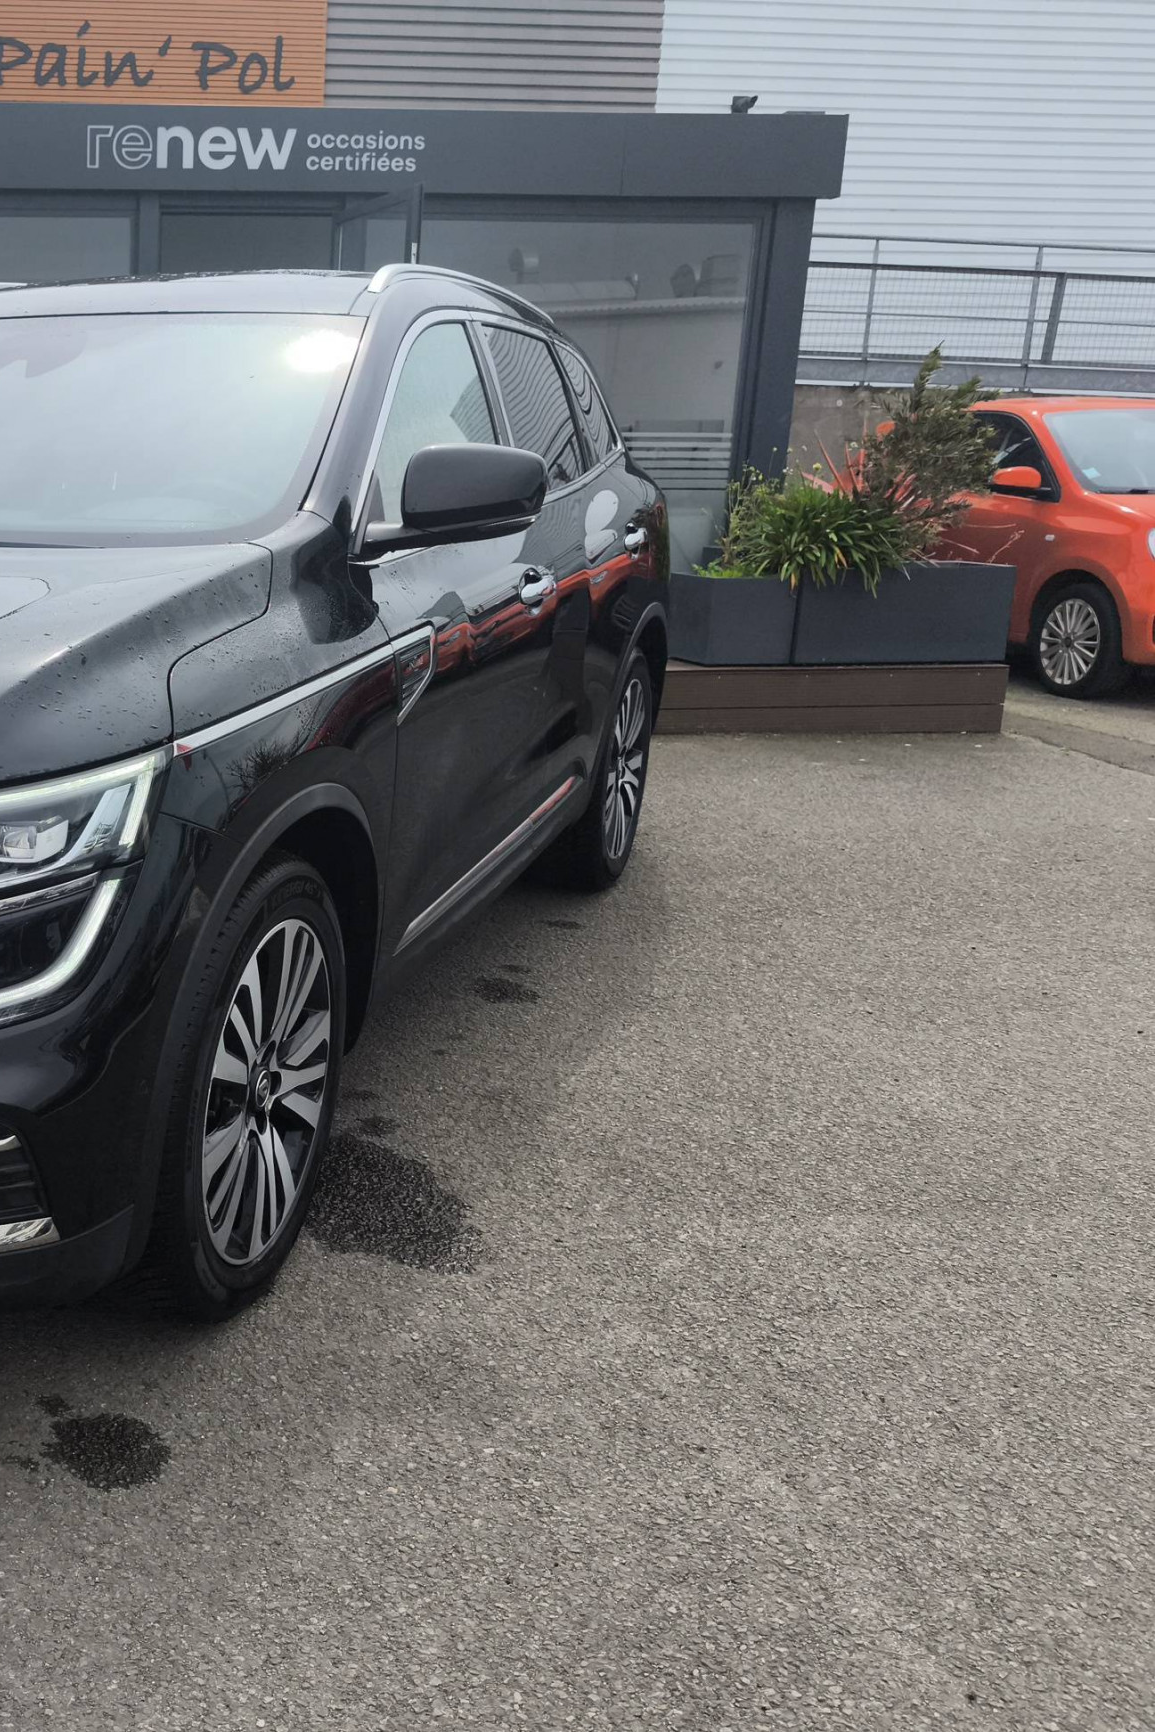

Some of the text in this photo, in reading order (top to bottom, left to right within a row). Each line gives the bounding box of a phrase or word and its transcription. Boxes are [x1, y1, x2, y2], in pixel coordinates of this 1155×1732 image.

[191, 35, 296, 94] Pol
[86, 124, 298, 170] renew
[306, 130, 426, 151] occasions
[305, 152, 417, 173] certifiées
